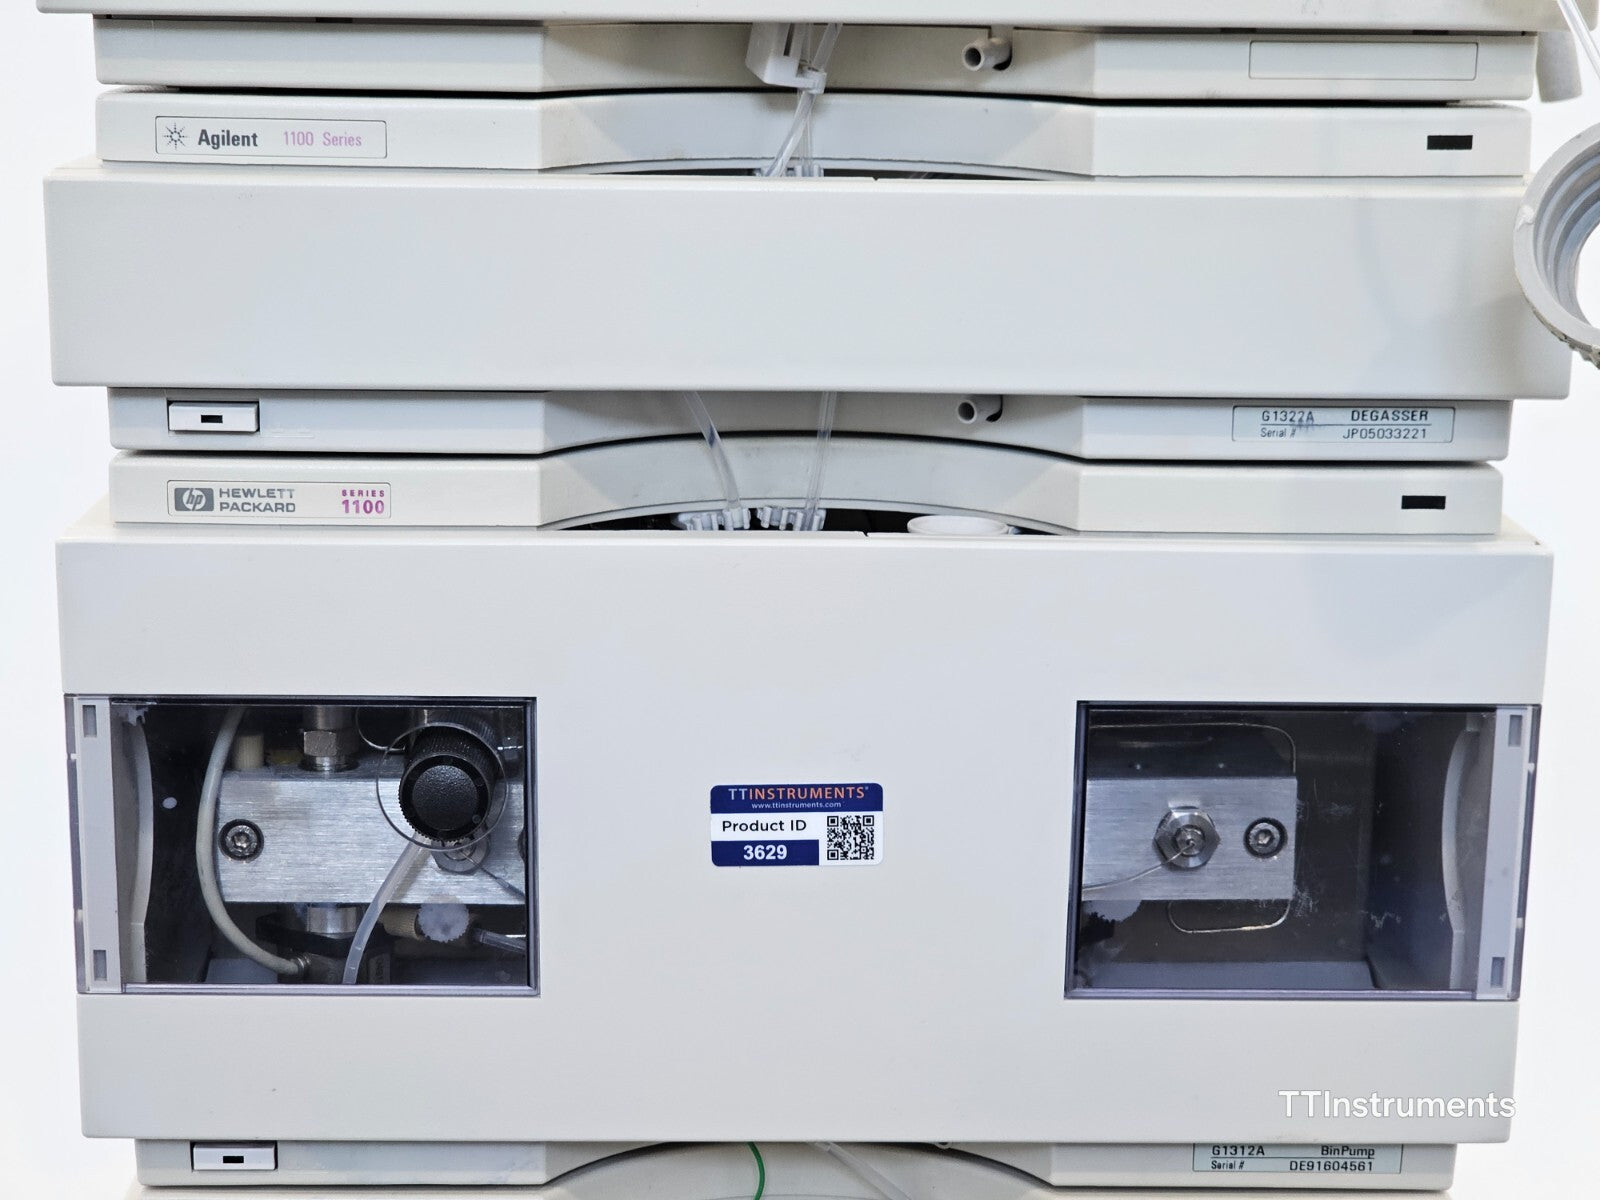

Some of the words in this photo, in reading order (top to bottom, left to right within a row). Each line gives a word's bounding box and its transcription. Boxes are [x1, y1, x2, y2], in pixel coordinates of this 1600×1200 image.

[197, 129, 258, 150] Agilent
[283, 131, 314, 146] 1100
[322, 131, 362, 147] Series
[1261, 410, 1315, 423] G1322A
[1350, 409, 1429, 422] DEGASSER
[1260, 427, 1287, 438] Serial
[1342, 428, 1427, 440] JP05033221
[219, 488, 296, 499] HEWLETT
[341, 489, 385, 498] SERIES
[219, 502, 296, 513] PACKARD
[341, 499, 385, 515] 1100
[751, 801, 842, 809] www.ttinstruments.com
[722, 819, 785, 832] Product
[790, 819, 807, 832] ID
[743, 844, 788, 860] 3629
[1211, 1145, 1265, 1156] G1312A
[1211, 1160, 1236, 1170] Serial
[1238, 1160, 1245, 1170] #
[1289, 1160, 1374, 1172] DE91604561
